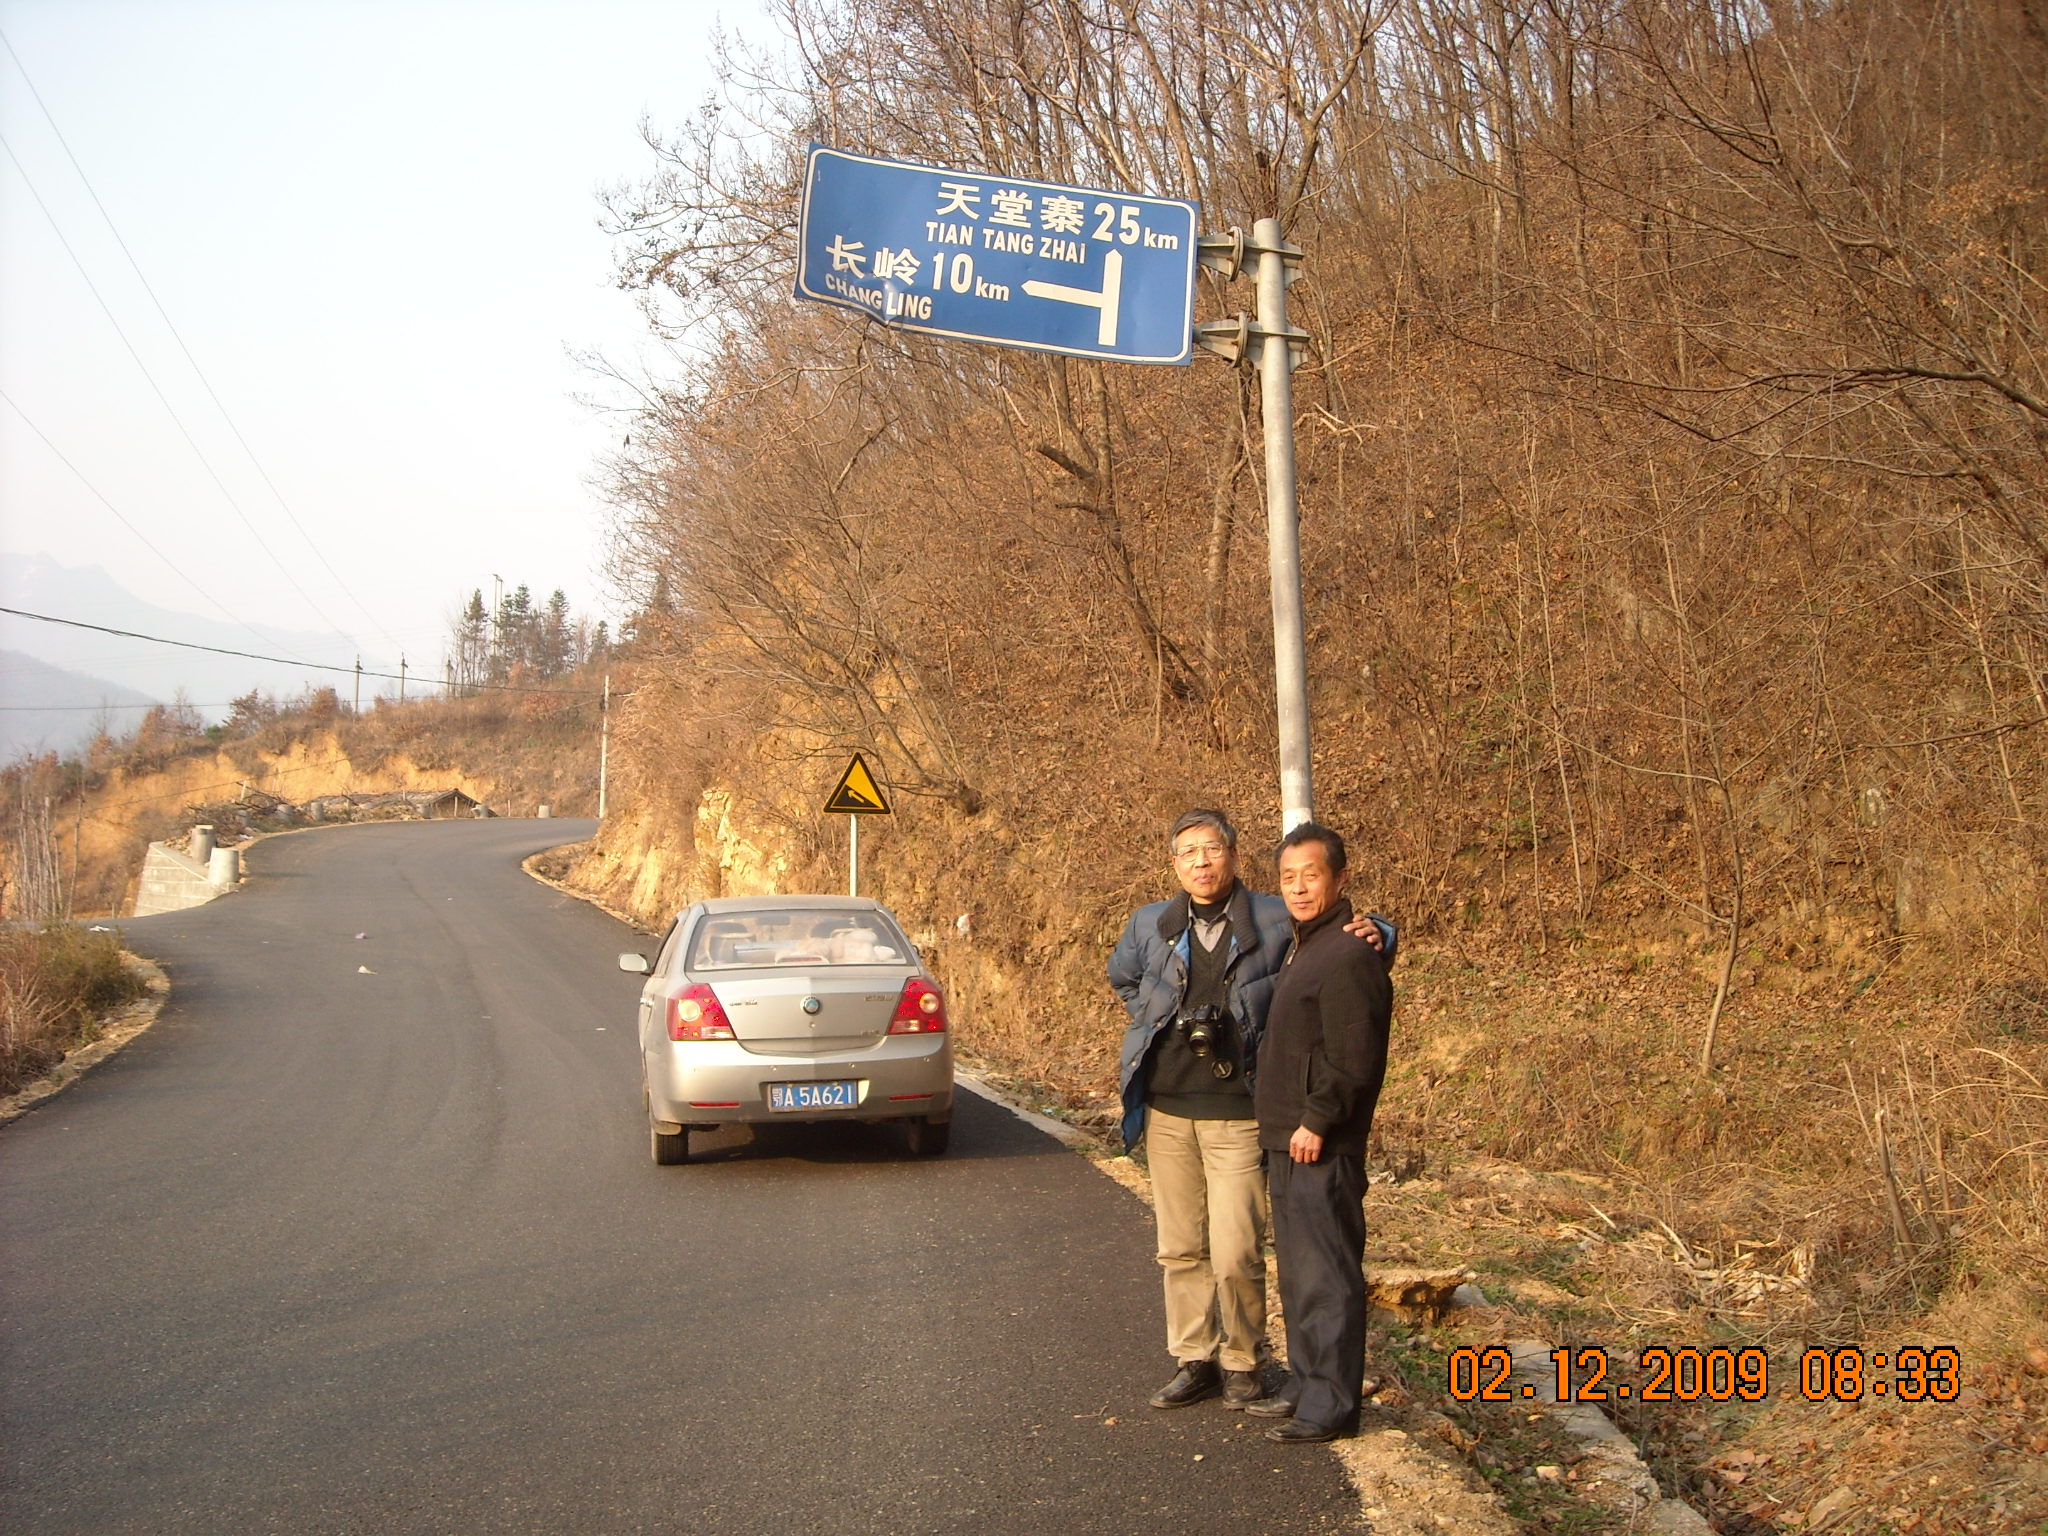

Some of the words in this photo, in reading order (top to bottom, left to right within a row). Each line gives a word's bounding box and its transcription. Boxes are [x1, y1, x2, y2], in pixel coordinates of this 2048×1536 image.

[925, 221, 974, 246] TIAN
[982, 228, 1034, 255] TANG
[935, 181, 1085, 236] 天堂寨
[1091, 202, 1179, 250] 25km
[825, 234, 922, 286] 长岭
[932, 251, 1010, 302] 10km
[825, 273, 883, 310] CHANG
[885, 291, 932, 320] LING
